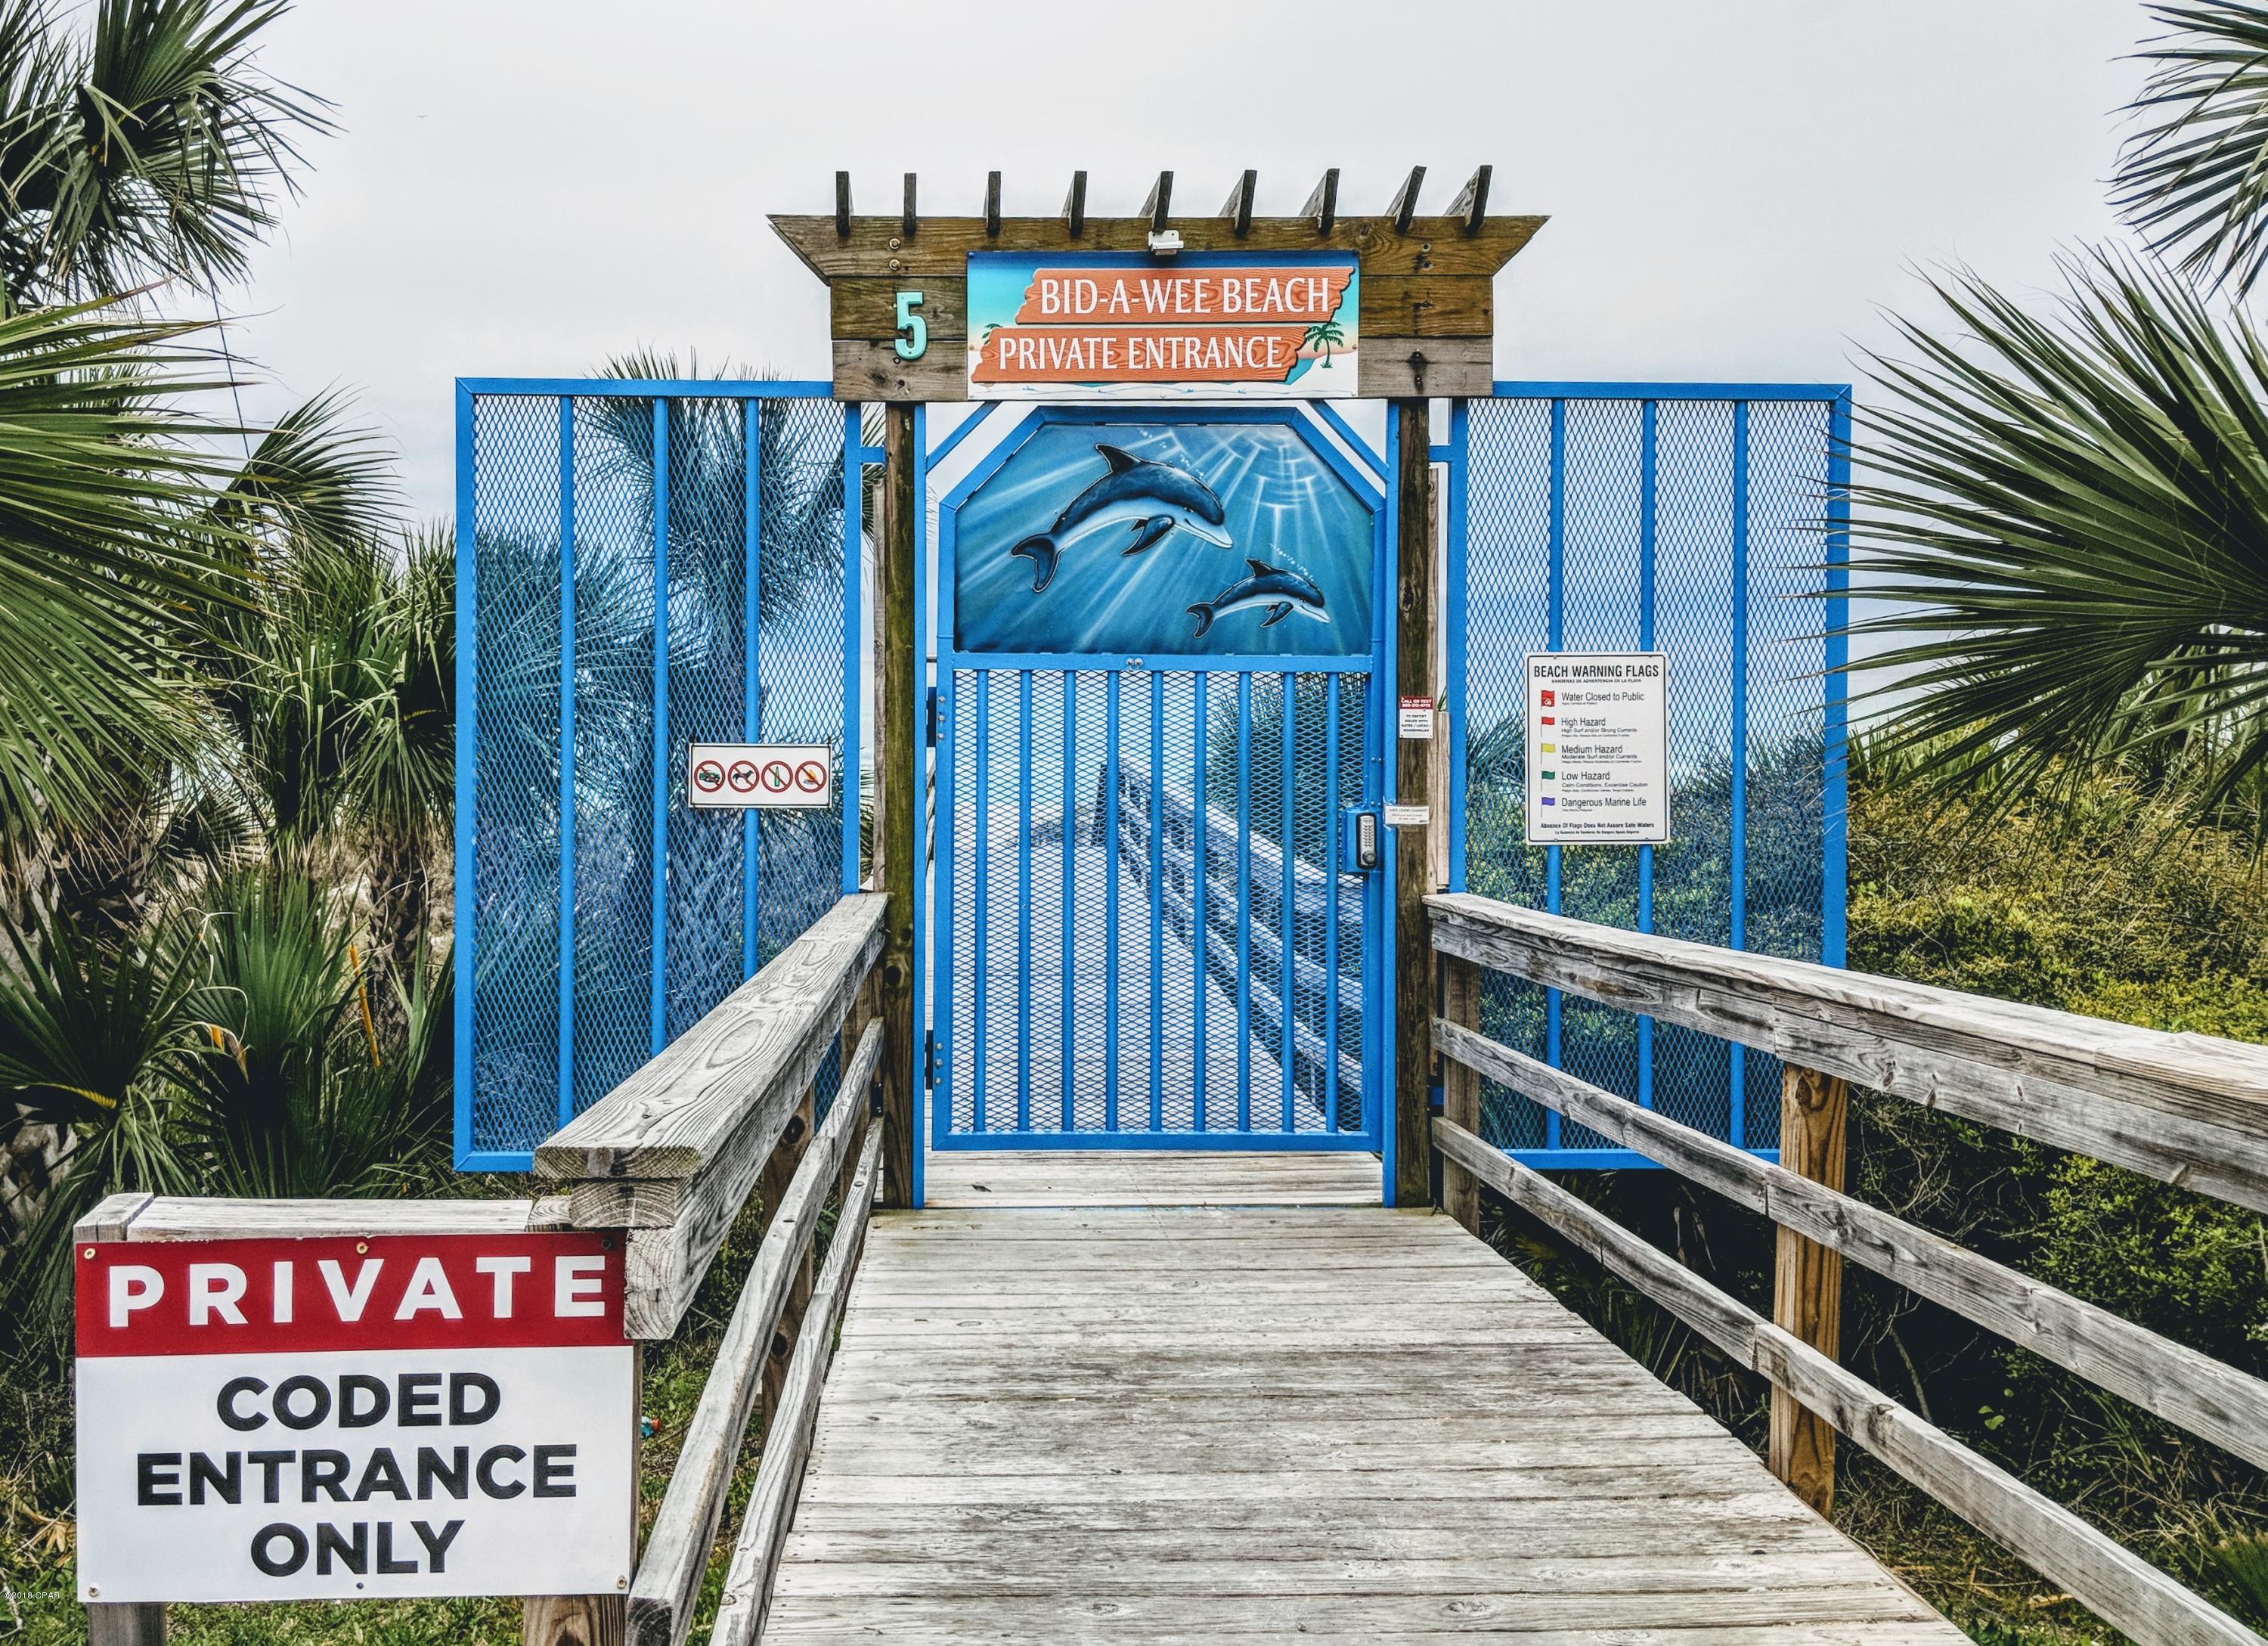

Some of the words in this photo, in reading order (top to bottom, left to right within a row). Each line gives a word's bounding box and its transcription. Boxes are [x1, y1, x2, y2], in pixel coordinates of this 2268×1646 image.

[1041, 277, 1210, 315] BID-A-WEE
[1222, 277, 1329, 315] BEACH
[895, 291, 927, 361] 5
[999, 336, 1117, 370] PRIVATE
[1129, 336, 1282, 370] ENTRANCE
[1534, 665, 1568, 677] BEACH
[1572, 665, 1622, 677] WARNING
[1626, 665, 1659, 677] FLAGS
[1561, 692, 1583, 701] Water
[1585, 692, 1611, 701] Closed
[1613, 692, 1620, 701] to
[1622, 692, 1645, 701] Public
[1561, 718, 1578, 728] High
[1580, 717, 1606, 727] Hazard
[1561, 745, 1592, 754] Medium
[1594, 745, 1623, 754] Hazard
[1561, 772, 1579, 780] Low
[1581, 771, 1610, 780] Hazard
[1562, 798, 1603, 809] Dangerous
[1605, 798, 1631, 806] Marine
[1633, 797, 1647, 806] Life
[109, 1255, 606, 1328] PRIVATE
[217, 1372, 501, 1431] CODED
[137, 1444, 577, 1506] ENTRANCE
[250, 1520, 465, 1577] ONLY
